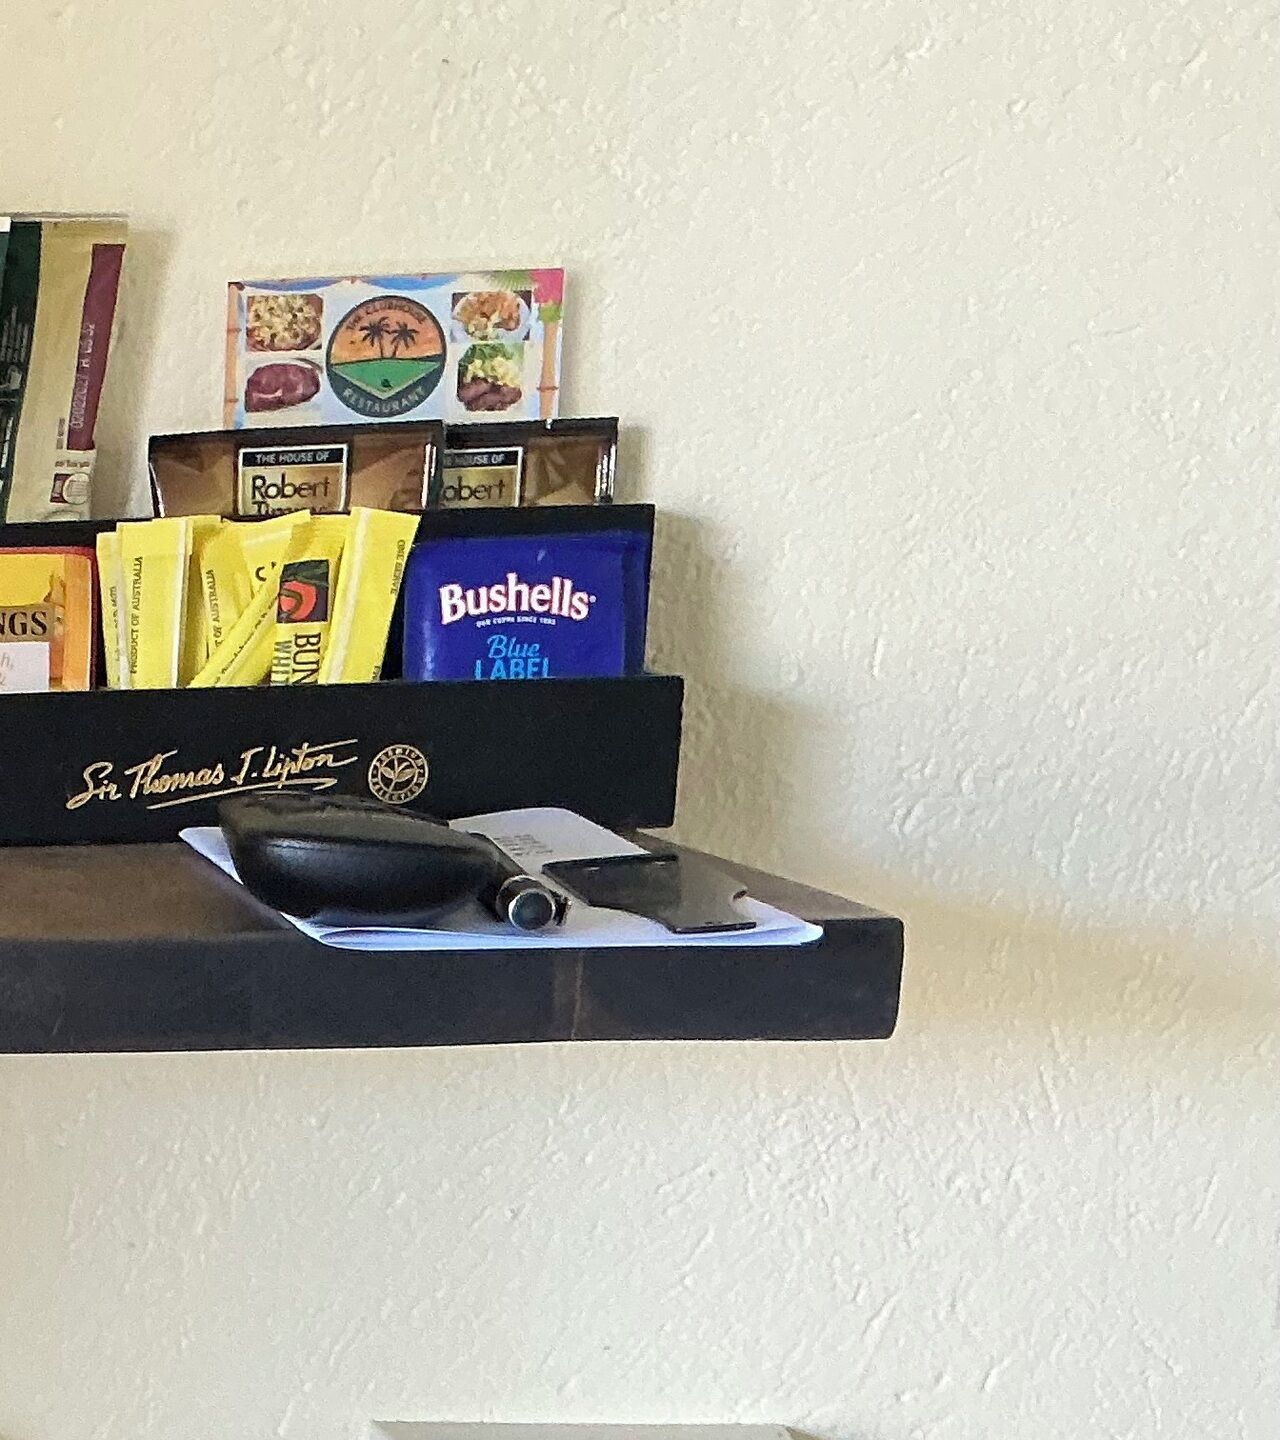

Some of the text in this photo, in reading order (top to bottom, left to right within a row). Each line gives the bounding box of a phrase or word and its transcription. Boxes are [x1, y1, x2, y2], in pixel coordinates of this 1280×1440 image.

[255, 450, 331, 464] THE HOUSE OF
[491, 453, 505, 464] OF
[251, 472, 331, 500] Robert
[442, 475, 506, 502] obert
[205, 568, 221, 624] AUSTRALIA
[438, 571, 591, 626] Bushells
[130, 555, 143, 675] PRODUCT OF AUSTRALIA
[212, 625, 223, 640] OF
[271, 639, 292, 685] WHIT
[292, 631, 321, 685] BUN
[487, 634, 541, 659] Blue
[65, 761, 122, 810] Sir
[124, 749, 225, 800] Thomas
[261, 739, 358, 790] Lipton
